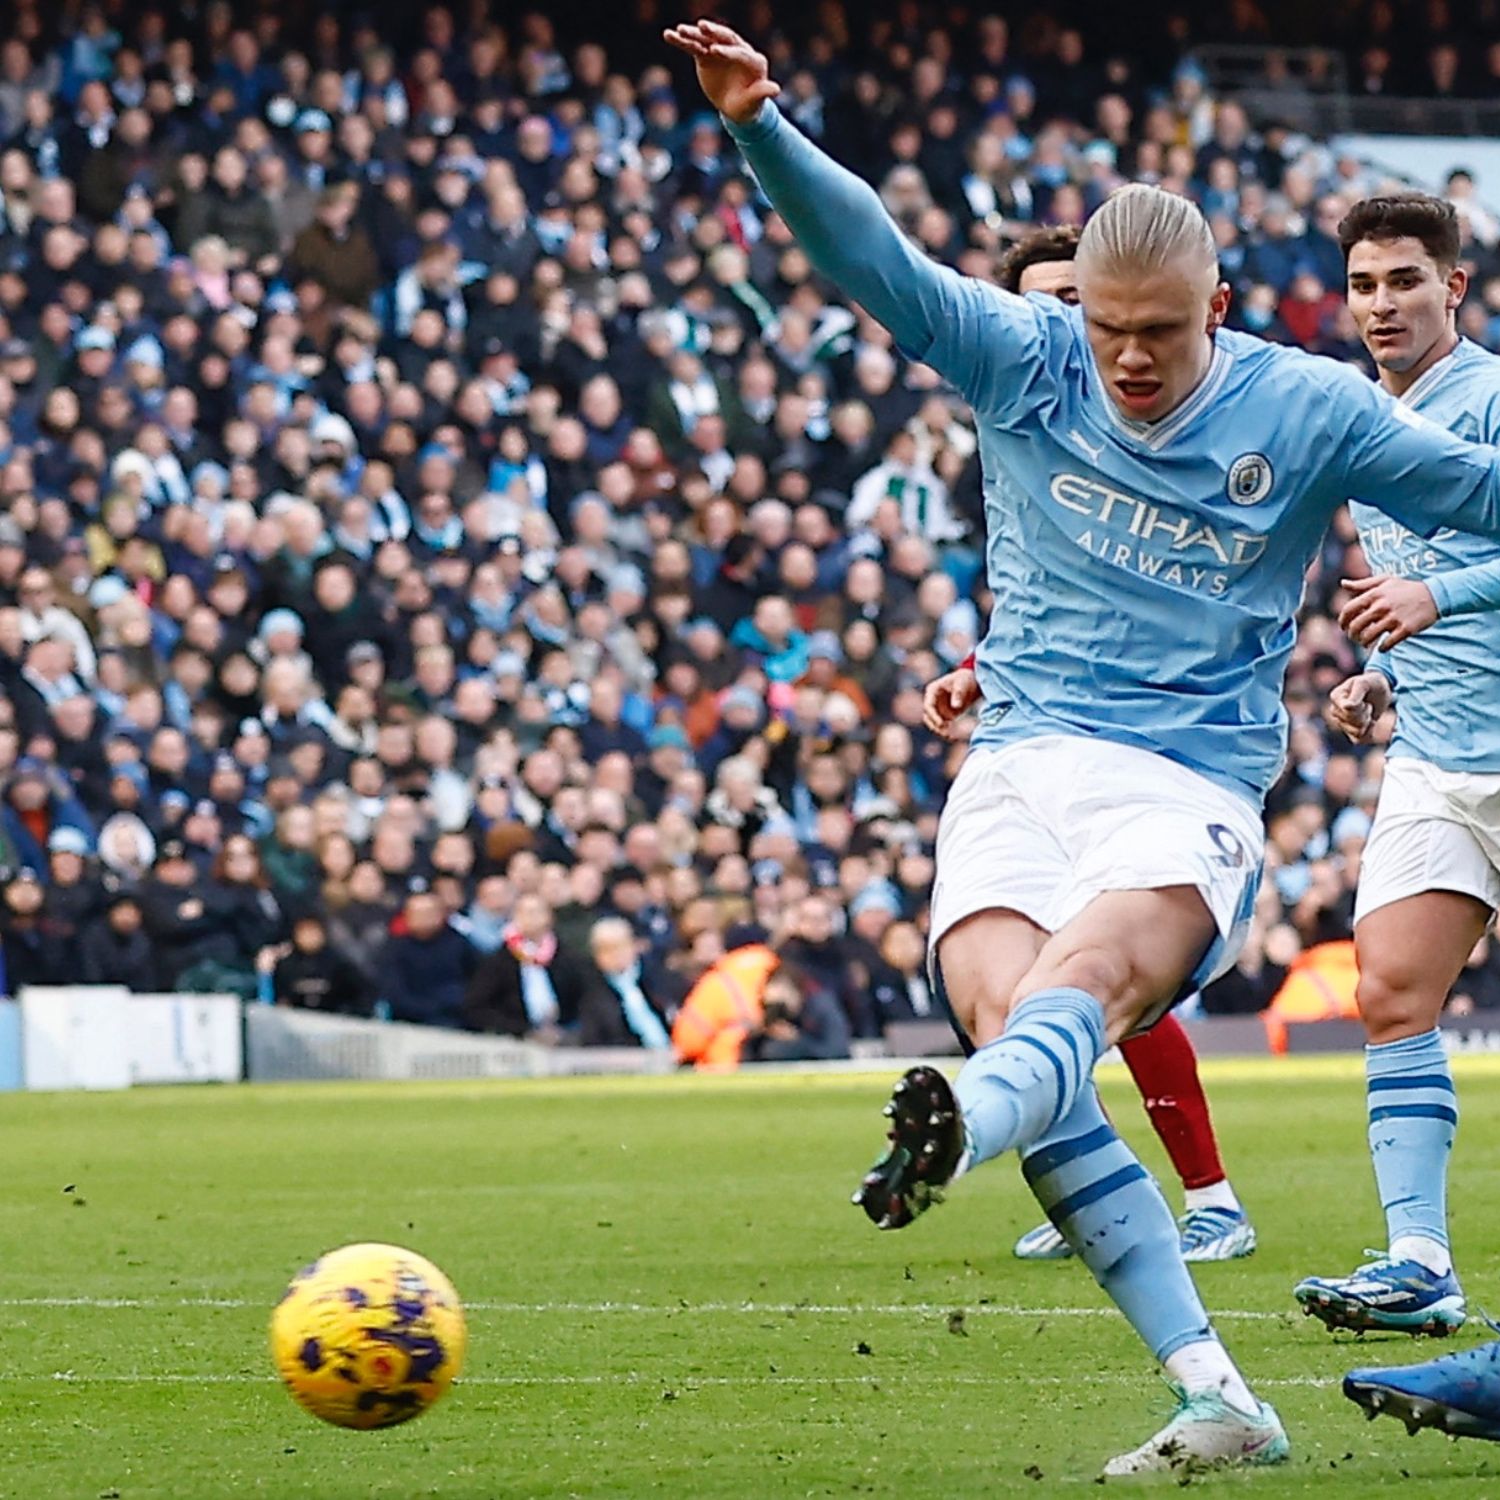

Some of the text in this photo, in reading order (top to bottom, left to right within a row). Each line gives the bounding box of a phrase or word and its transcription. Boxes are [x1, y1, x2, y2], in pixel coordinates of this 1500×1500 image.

[1050, 472, 1269, 565] ETIHAD
[1075, 530, 1229, 595] AIRWAYS
[1206, 823, 1244, 869] 9
